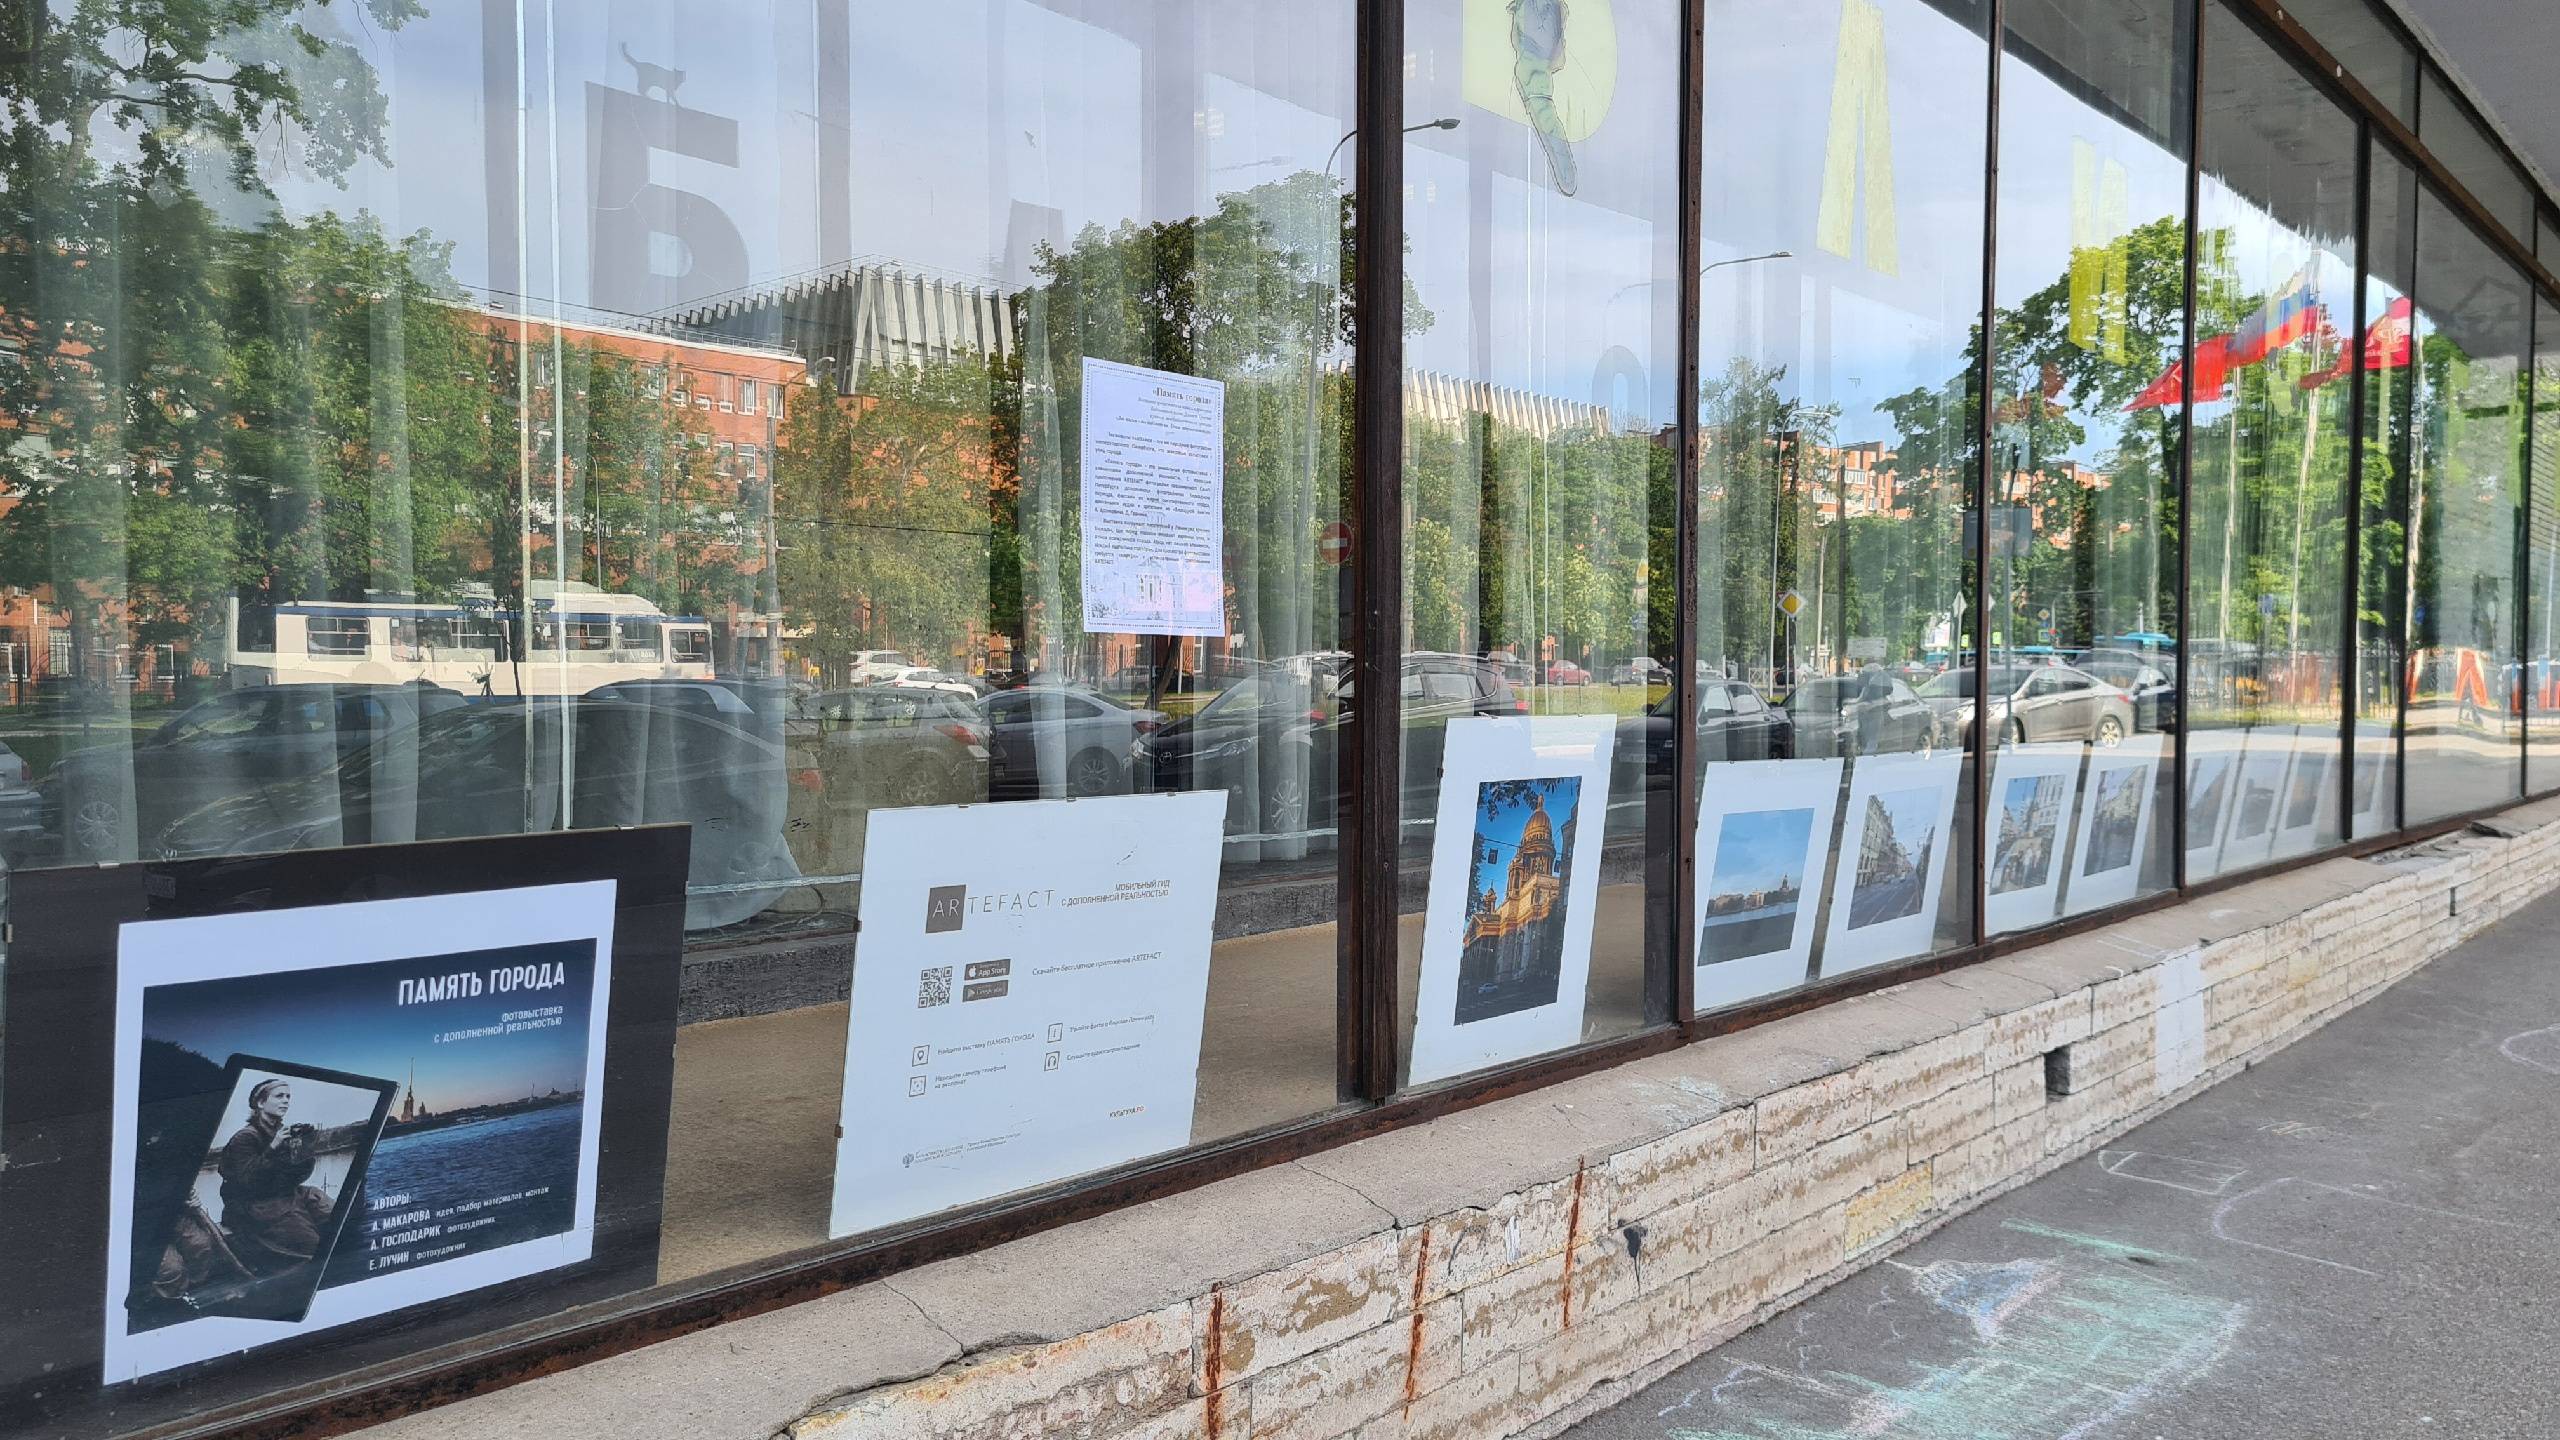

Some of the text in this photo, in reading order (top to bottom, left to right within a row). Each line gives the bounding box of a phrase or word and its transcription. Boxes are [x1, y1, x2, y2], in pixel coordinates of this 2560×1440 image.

[1115, 880, 1156, 891] МОБИЛЬНЫЙ
[932, 888, 1055, 918] ARTEFACT
[1067, 892, 1120, 908] ДОПОЛНЕННОЙ
[1120, 889, 1169, 901] РЕАЛЬНОСТЬЮ
[398, 961, 566, 1006] ПАМЯТЬ ГОРОДА
[433, 1017, 562, 1044] с дополненной реальностью
[372, 1192, 412, 1211] АВТОРЫ:
[371, 1221, 381, 1232] А.
[382, 1209, 431, 1230] МАКАРОВА
[370, 1239, 380, 1251] А.
[381, 1224, 442, 1249] ГОСПОДАРИК
[369, 1259, 378, 1271] Е.
[379, 1251, 410, 1268] ЛУЧИН
